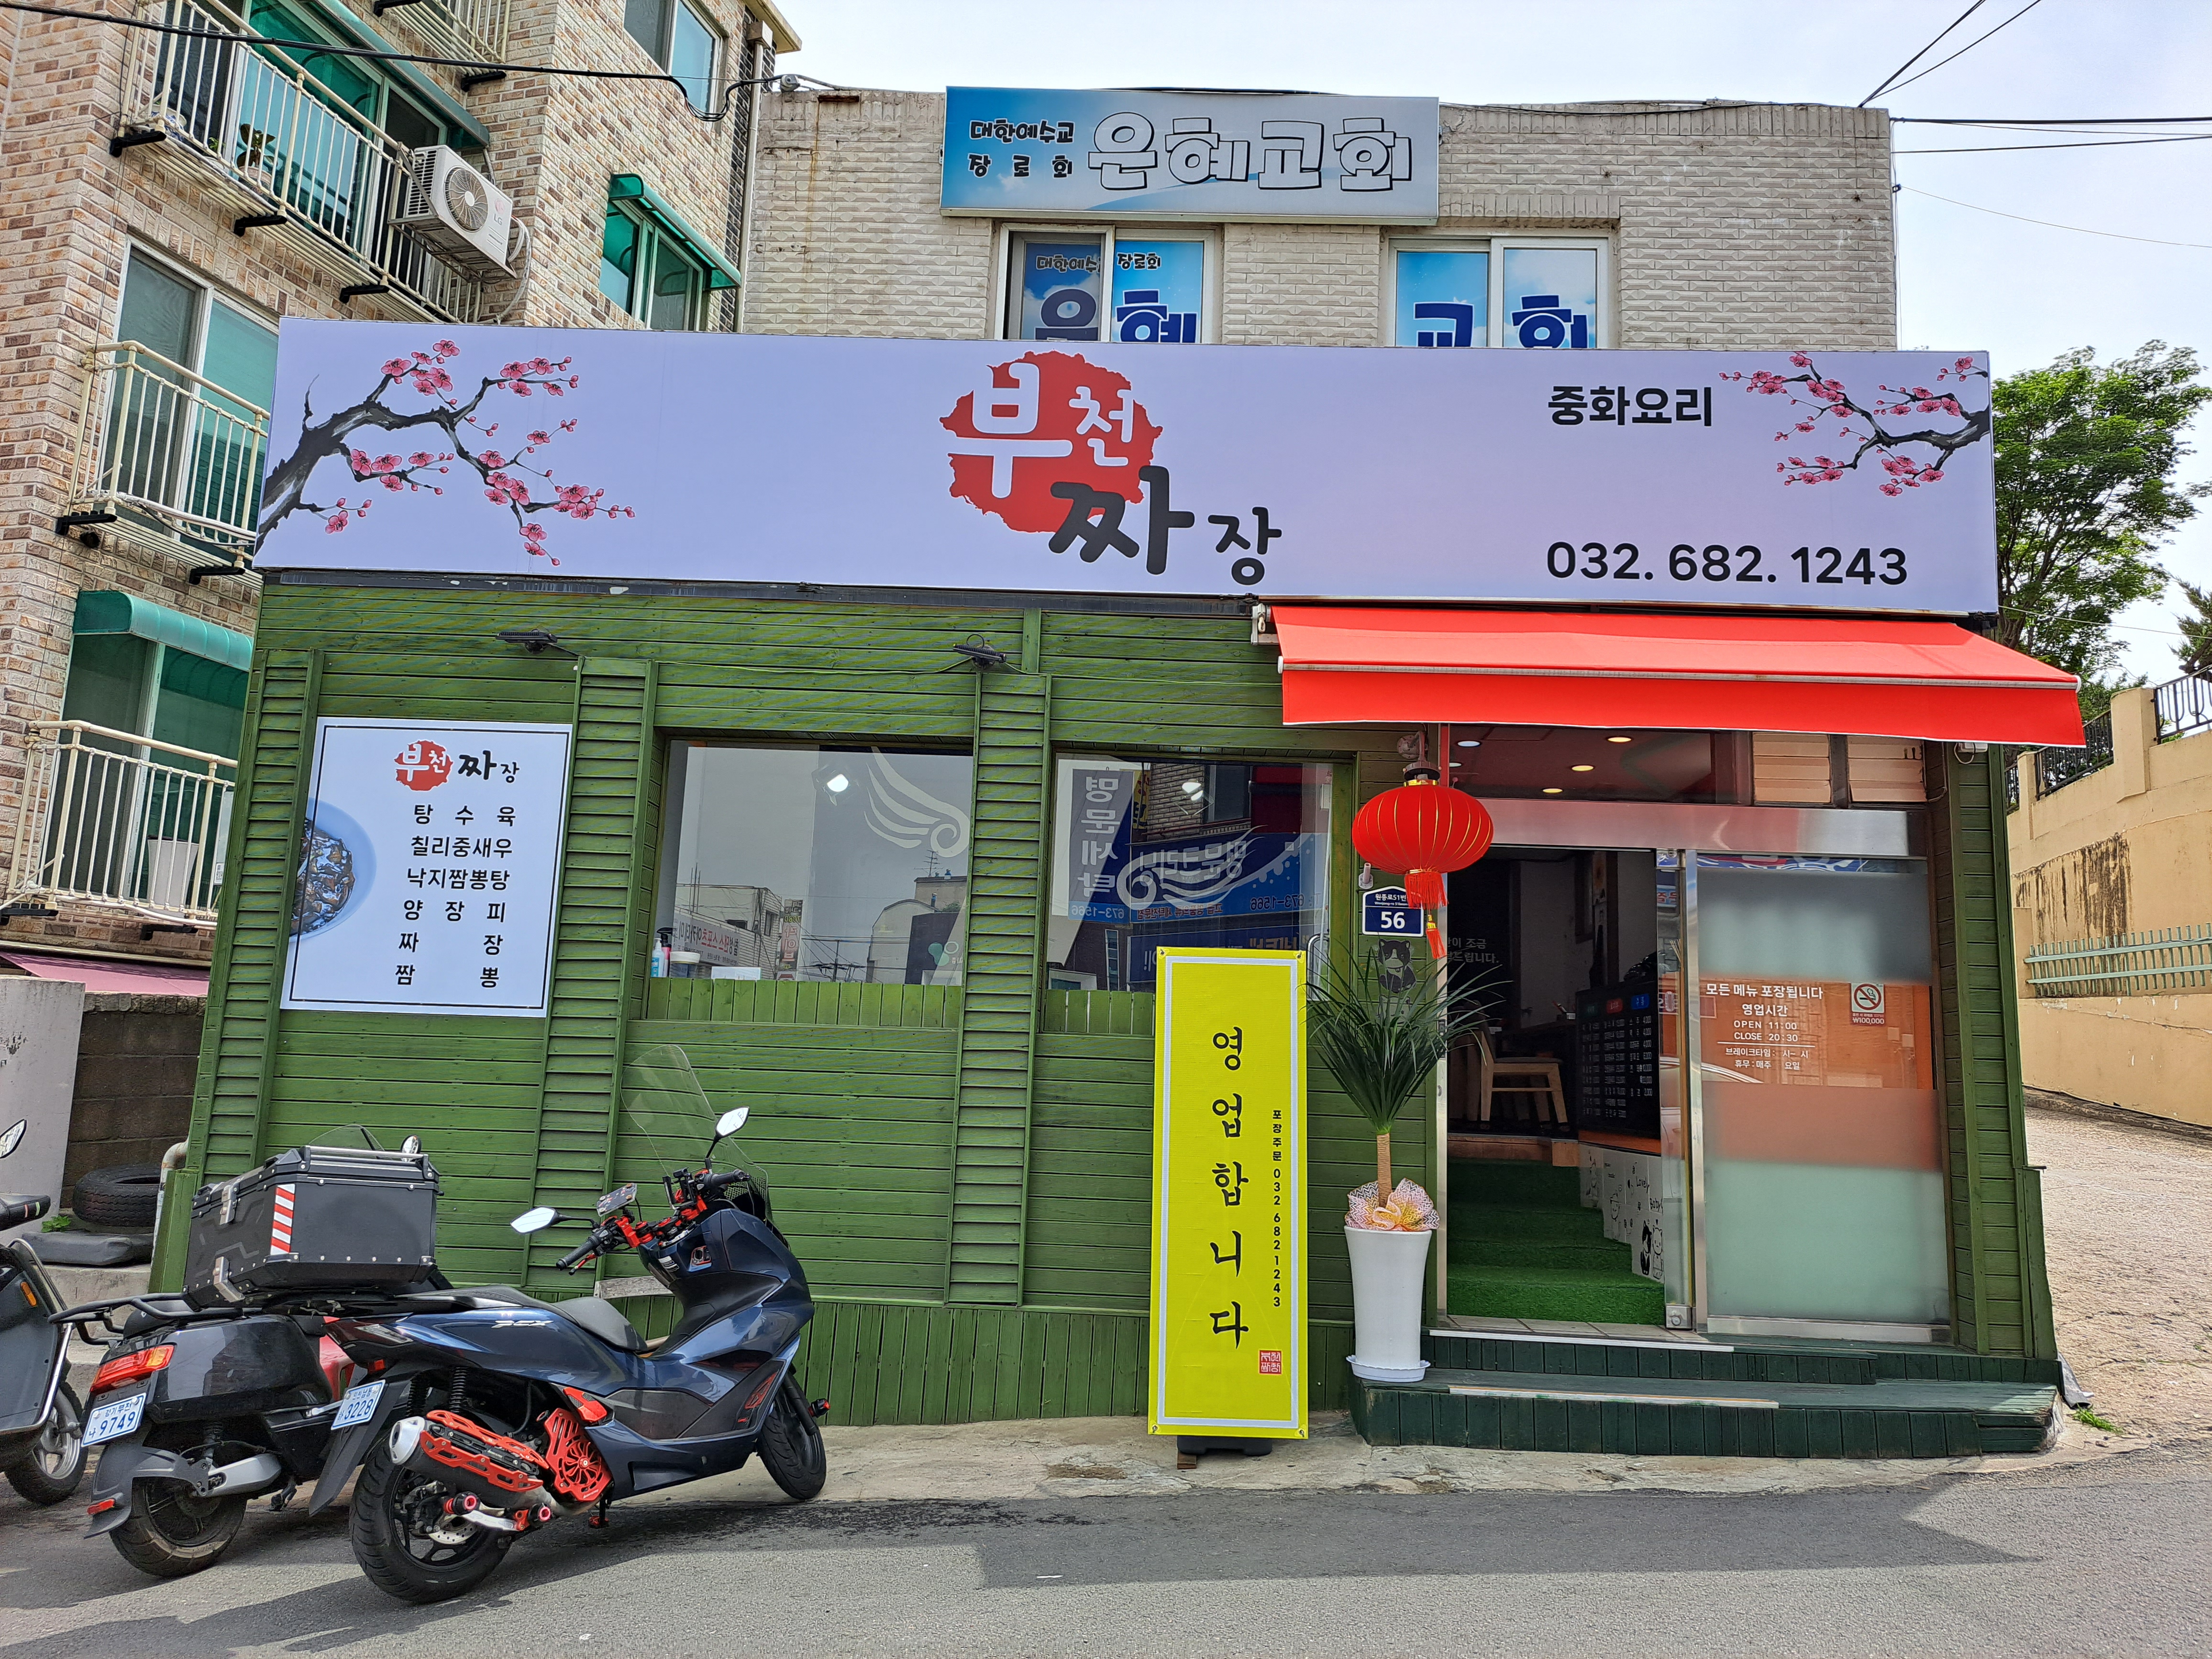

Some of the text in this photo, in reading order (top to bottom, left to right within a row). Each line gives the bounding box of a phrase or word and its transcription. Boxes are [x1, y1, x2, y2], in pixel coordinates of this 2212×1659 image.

[969, 118, 1074, 144] 대한예수교
[1088, 111, 1412, 191] 은혜교회
[494, 213, 502, 225] LG
[1036, 254, 1100, 273] 대한예수
[1117, 252, 1161, 270] 장로회
[1548, 386, 1712, 427] 중화요리
[1790, 546, 1908, 586] 1243
[411, 835, 513, 859] 칠리중새우
[407, 868, 510, 891] 낙지짬뽕탕
[1375, 893, 1407, 902] 원종로51번
[1381, 911, 1405, 929] 56
[1465, 938, 1487, 949] 조금
[1706, 983, 1823, 1000] 모든 메뉴 포장됩니다
[1742, 1004, 1788, 1017] 영업시간
[1734, 1020, 1762, 1029] OPEN
[1734, 1032, 1762, 1041] CLOSE
[1801, 1050, 1809, 1059] 시
[1784, 1062, 1800, 1071] 요일
[1272, 1110, 1282, 1161] 포장주문
[1209, 1026, 1249, 1349] 영업합니다
[491, 1320, 554, 1329] PCX
[344, 1398, 374, 1420] 3228
[88, 1411, 136, 1438] 나 9749
